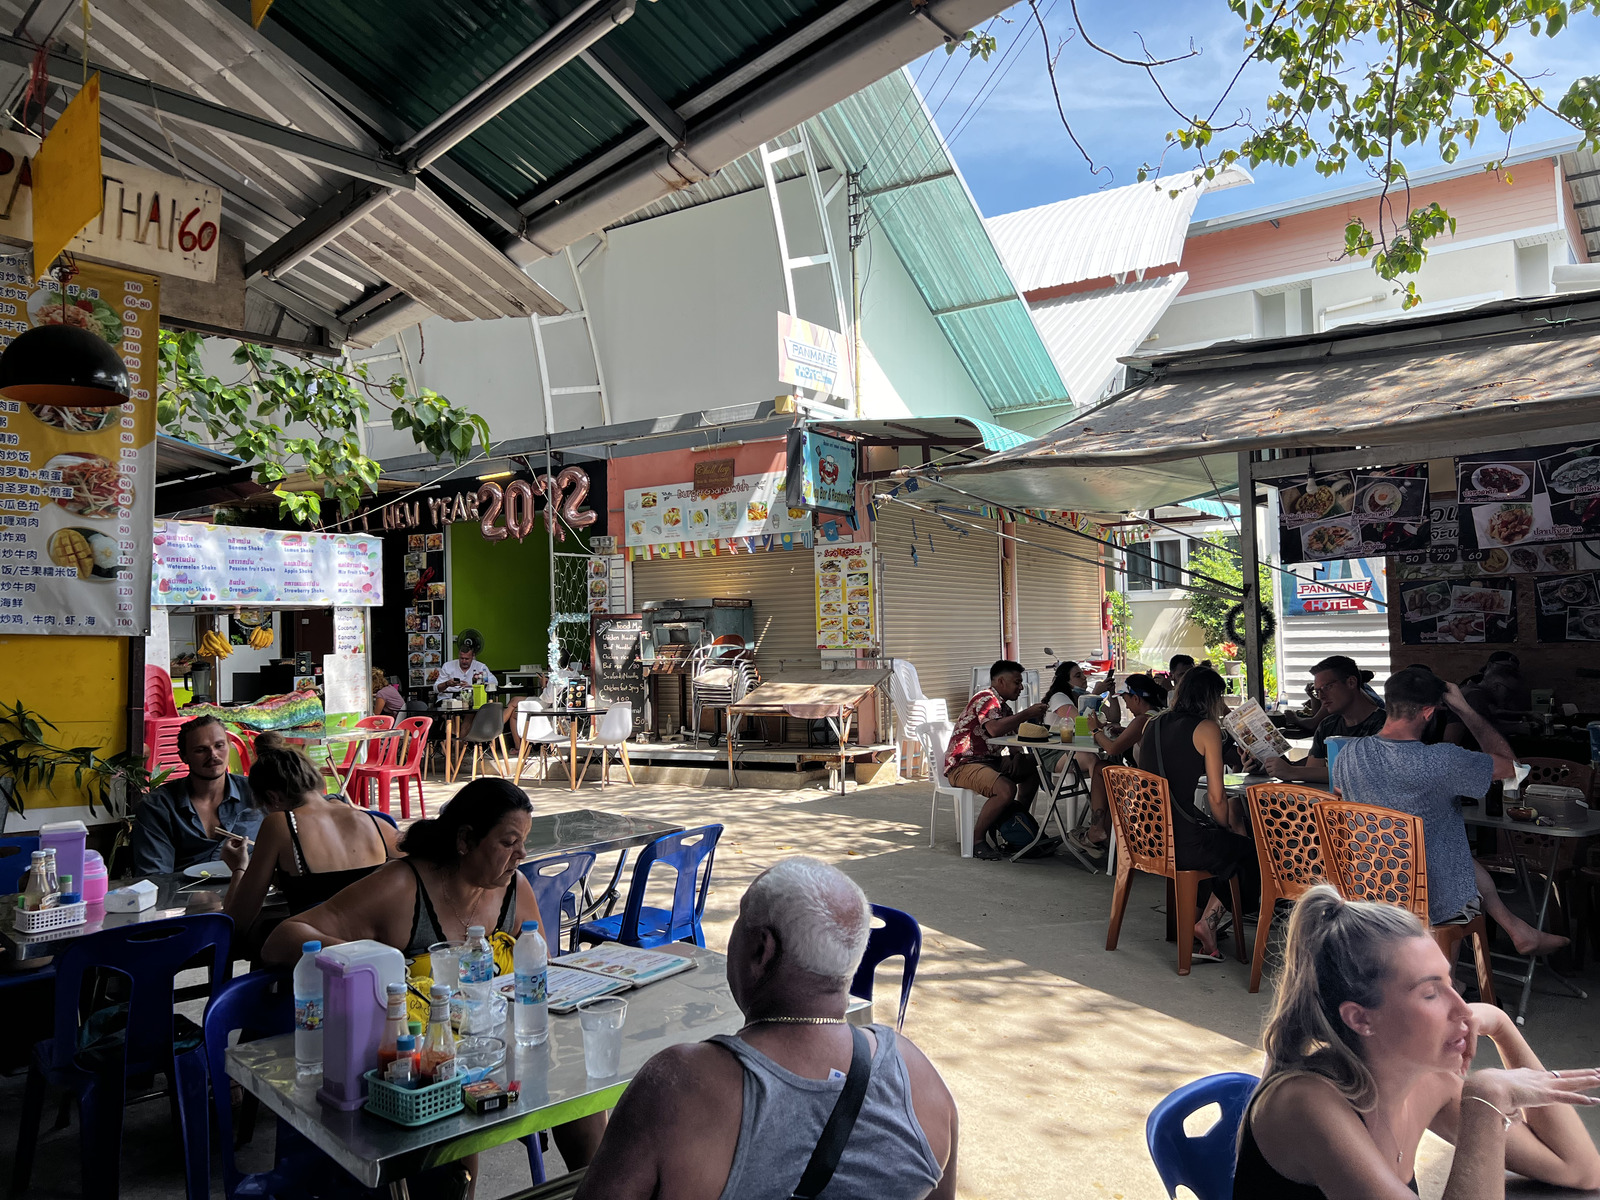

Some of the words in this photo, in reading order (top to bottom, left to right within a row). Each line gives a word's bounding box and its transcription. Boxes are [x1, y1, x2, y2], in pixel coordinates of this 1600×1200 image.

[99, 174, 177, 253] THAI
[178, 206, 217, 253] 60
[125, 283, 142, 292] 100
[125, 297, 151, 309] 60-80
[125, 312, 137, 321] 60
[125, 328, 141, 337] 120
[125, 343, 140, 352] 100
[792, 344, 838, 367] PANMANEE
[122, 404, 133, 412] 80
[122, 419, 133, 427] 80
[122, 434, 133, 442] 80
[122, 450, 137, 458] 120
[121, 465, 136, 473] 100
[120, 480, 131, 488] 80
[120, 495, 131, 503] 80
[382, 500, 420, 533] NEW
[427, 490, 480, 530] YEAR
[119, 526, 130, 534] 80
[119, 541, 134, 549] 120
[167, 541, 185, 549] Mango
[1405, 554, 1420, 563] 50
[1436, 553, 1451, 562] 70
[1468, 552, 1483, 560] 60
[119, 557, 134, 565] 120
[118, 572, 133, 580] 100
[118, 588, 133, 596] 120
[1297, 581, 1373, 595] PANMANEE
[117, 603, 133, 611] 120
[1311, 599, 1358, 611] HOTEL
[116, 618, 133, 626] 100
[616, 621, 630, 630] Food
[631, 622, 642, 630] Me
